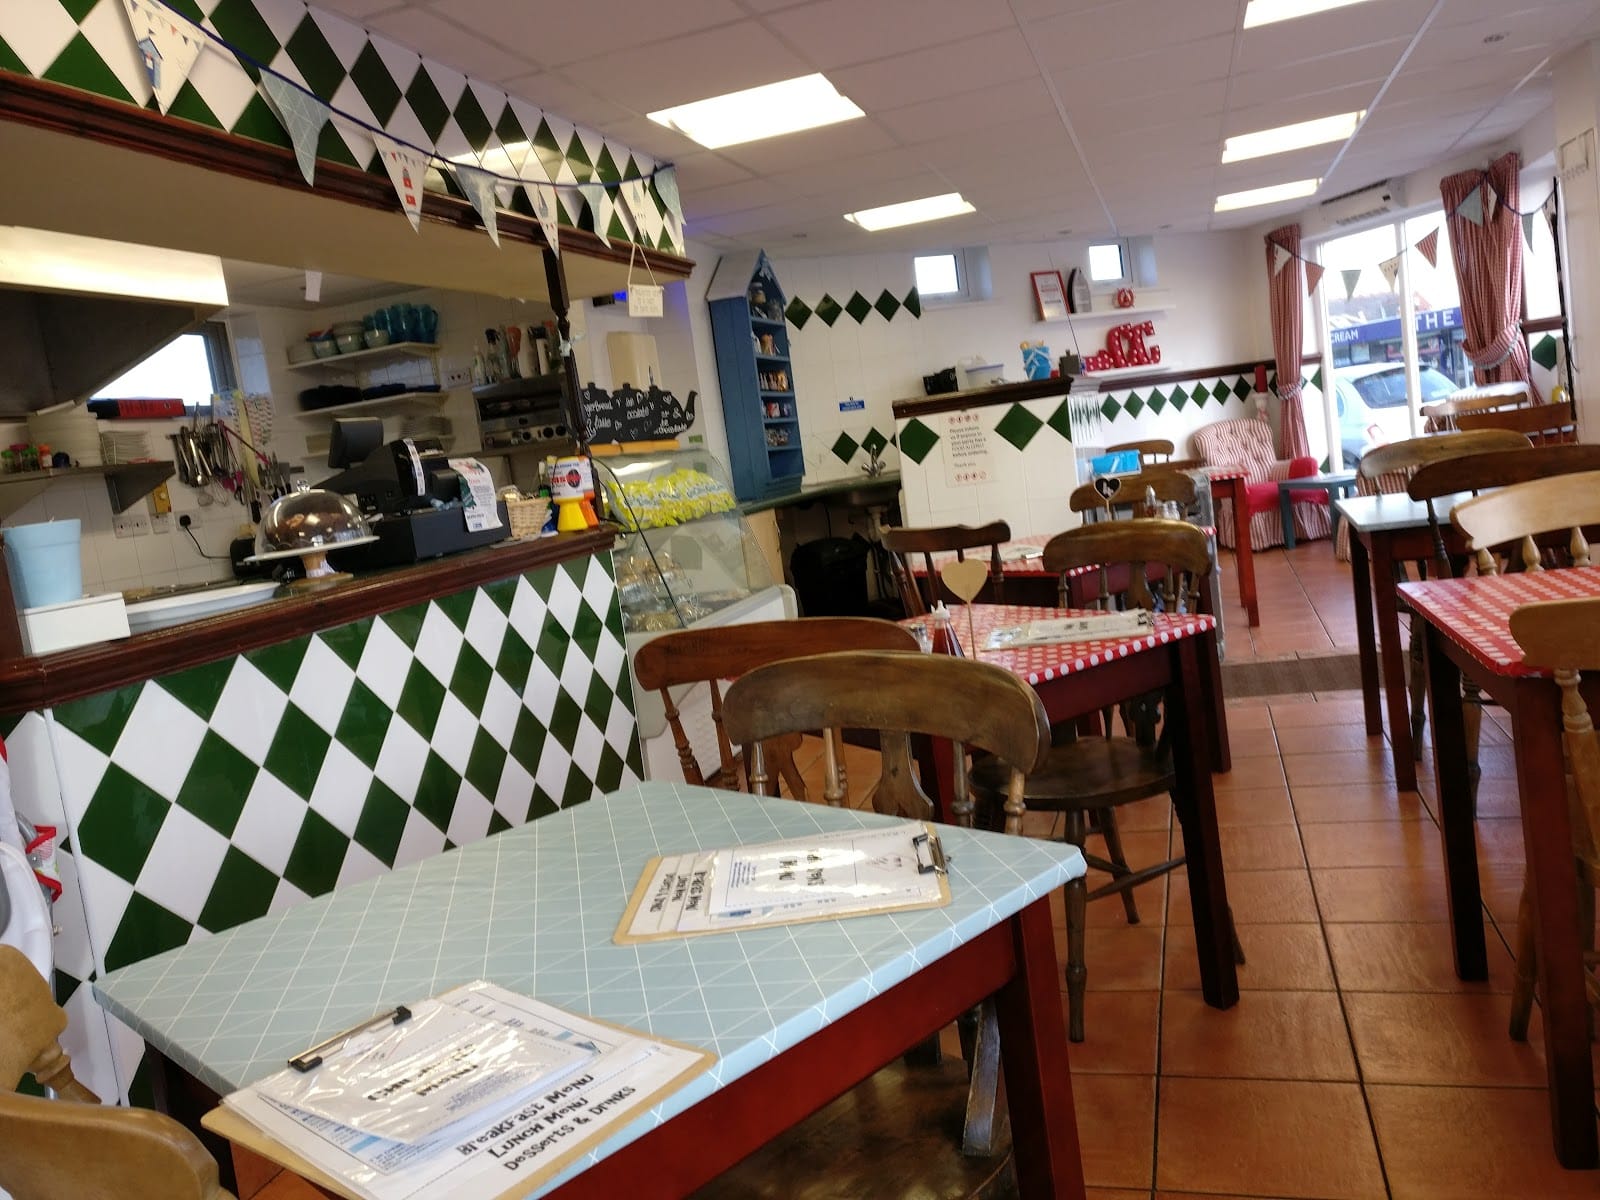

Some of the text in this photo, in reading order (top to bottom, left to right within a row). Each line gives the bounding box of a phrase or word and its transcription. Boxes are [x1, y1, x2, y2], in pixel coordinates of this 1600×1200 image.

[1415, 310, 1455, 331] THE
[1331, 329, 1359, 343] CREAM
[573, 1116, 592, 1126] &
